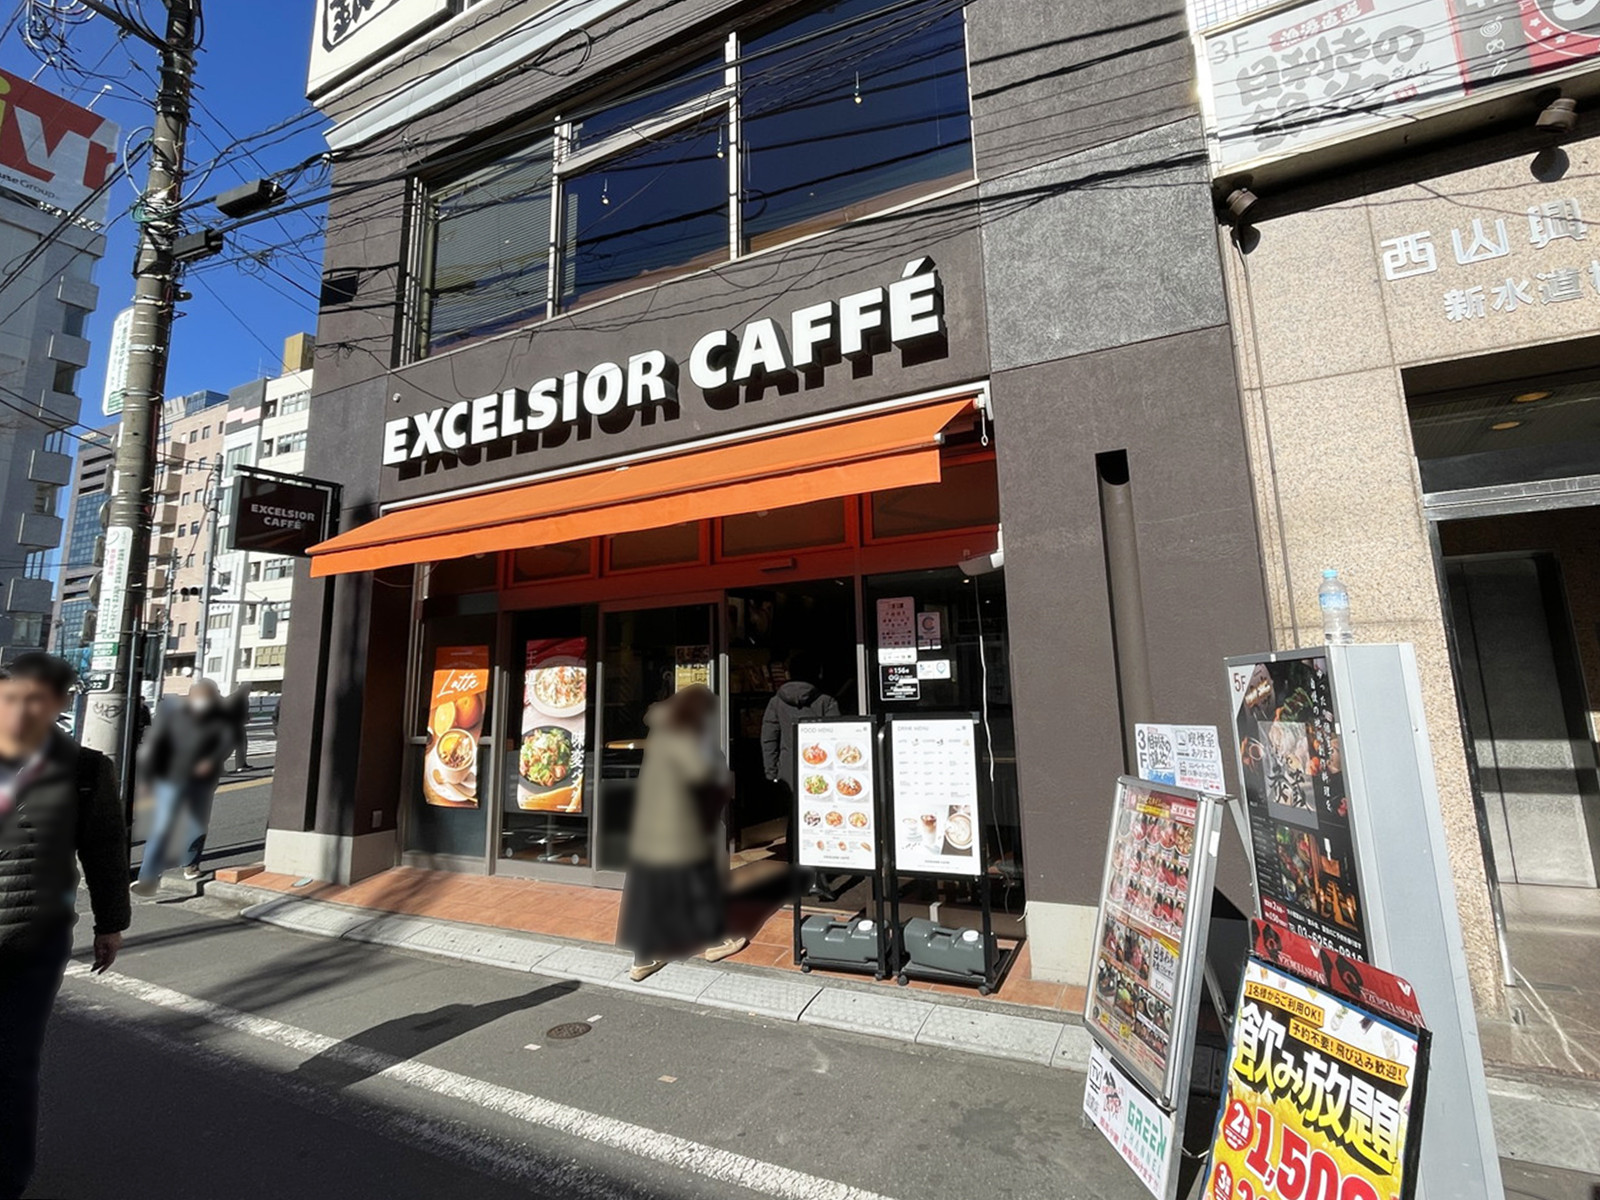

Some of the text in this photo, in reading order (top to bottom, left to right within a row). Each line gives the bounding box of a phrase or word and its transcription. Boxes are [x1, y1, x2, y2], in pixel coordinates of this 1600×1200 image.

[1210, 29, 1250, 66] 3F
[1236, 25, 1425, 106] 目利きの
[20, 179, 56, 199] Group
[383, 256, 942, 467] EXCELSIOR CAFFÉ
[251, 503, 315, 521] EXCELSIOR
[263, 516, 302, 530] CAFFÉ
[436, 669, 480, 698] Latte
[1233, 672, 1247, 693] 5F
[1249, 983, 1322, 1023] 1名様からご利用OK!
[1232, 1002, 1401, 1174] 飲み放題
[1128, 1100, 1168, 1161] GREEN
[1124, 1127, 1161, 1179] CHANNEL
